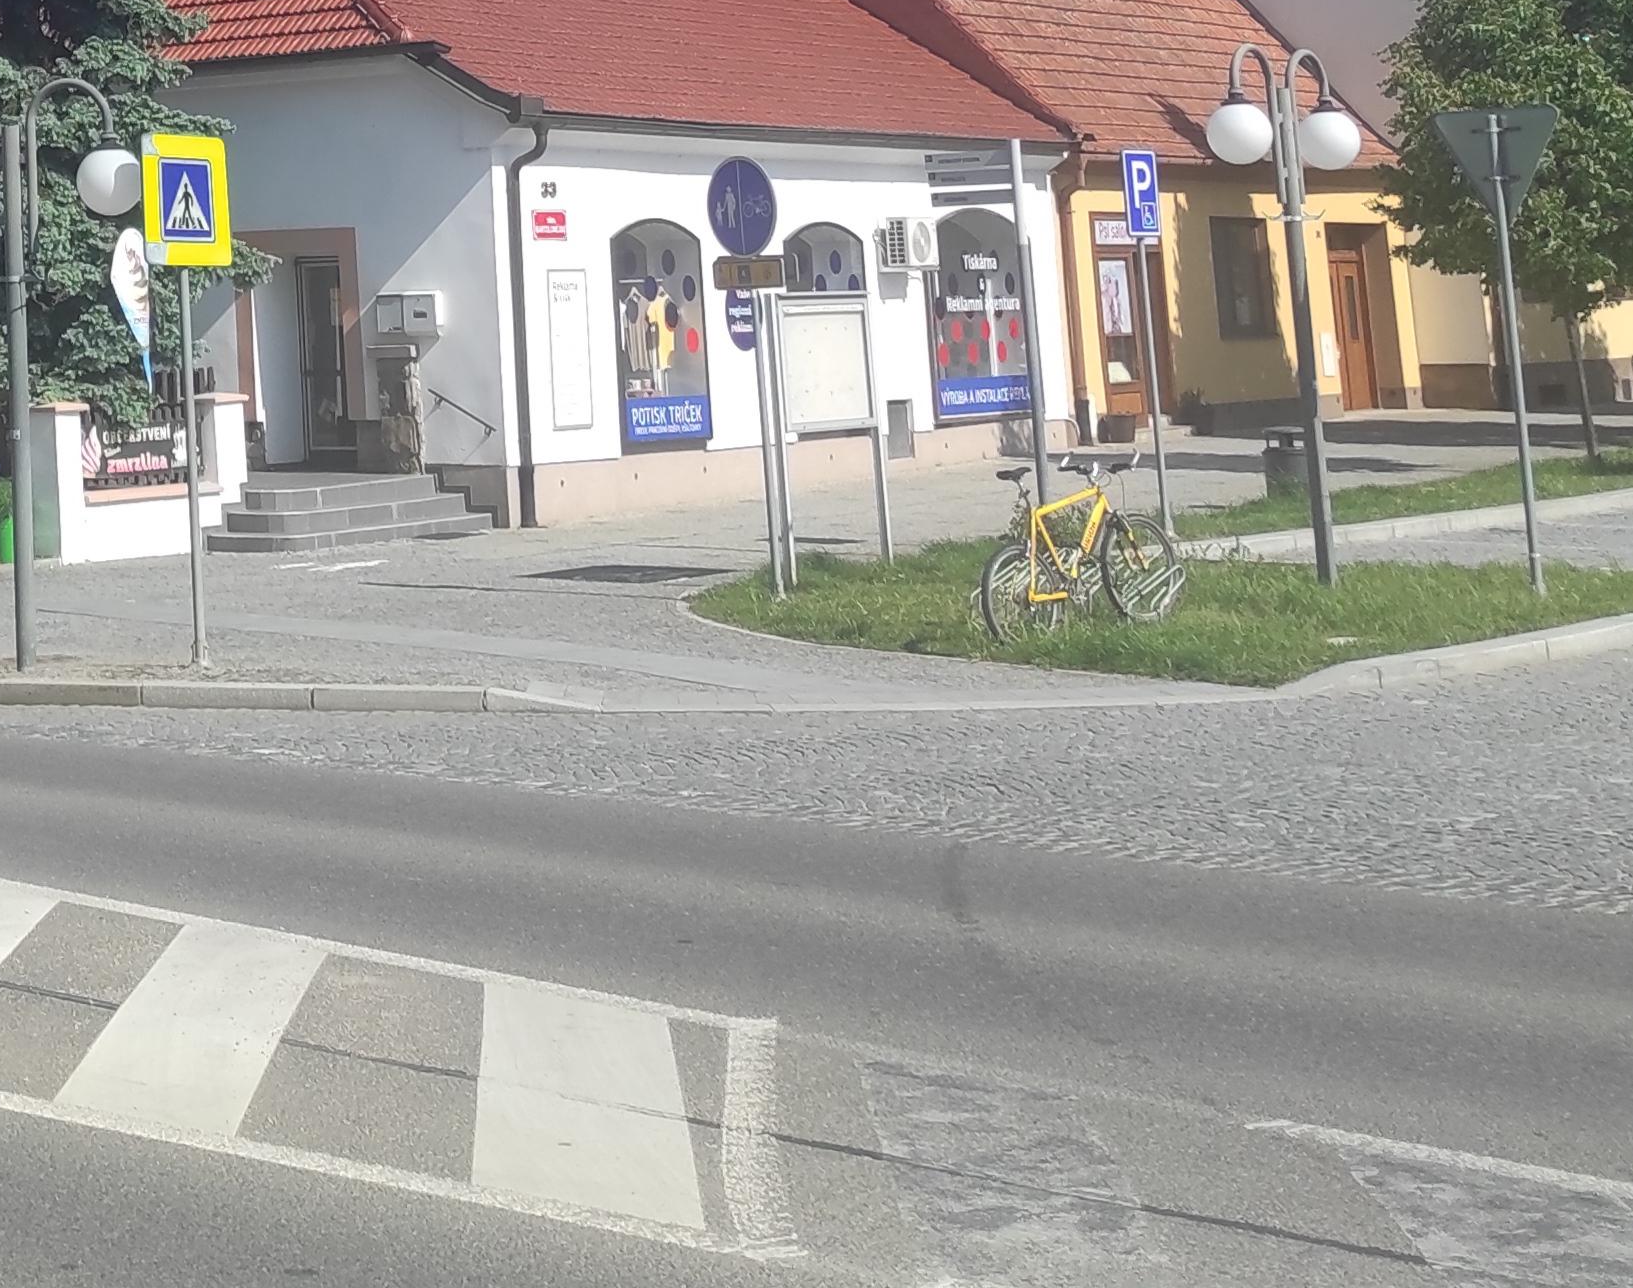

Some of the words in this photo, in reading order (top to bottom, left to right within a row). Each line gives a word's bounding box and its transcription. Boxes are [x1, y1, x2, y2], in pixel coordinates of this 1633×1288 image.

[541, 181, 556, 198] 33
[1131, 160, 1152, 208] P
[962, 253, 998, 270] Tiskárna
[946, 294, 983, 312] Reklamní
[985, 297, 1021, 312] agentura
[631, 406, 667, 425] POTISK
[669, 400, 703, 424] TRIČEK
[107, 452, 169, 473] zmrzlina
